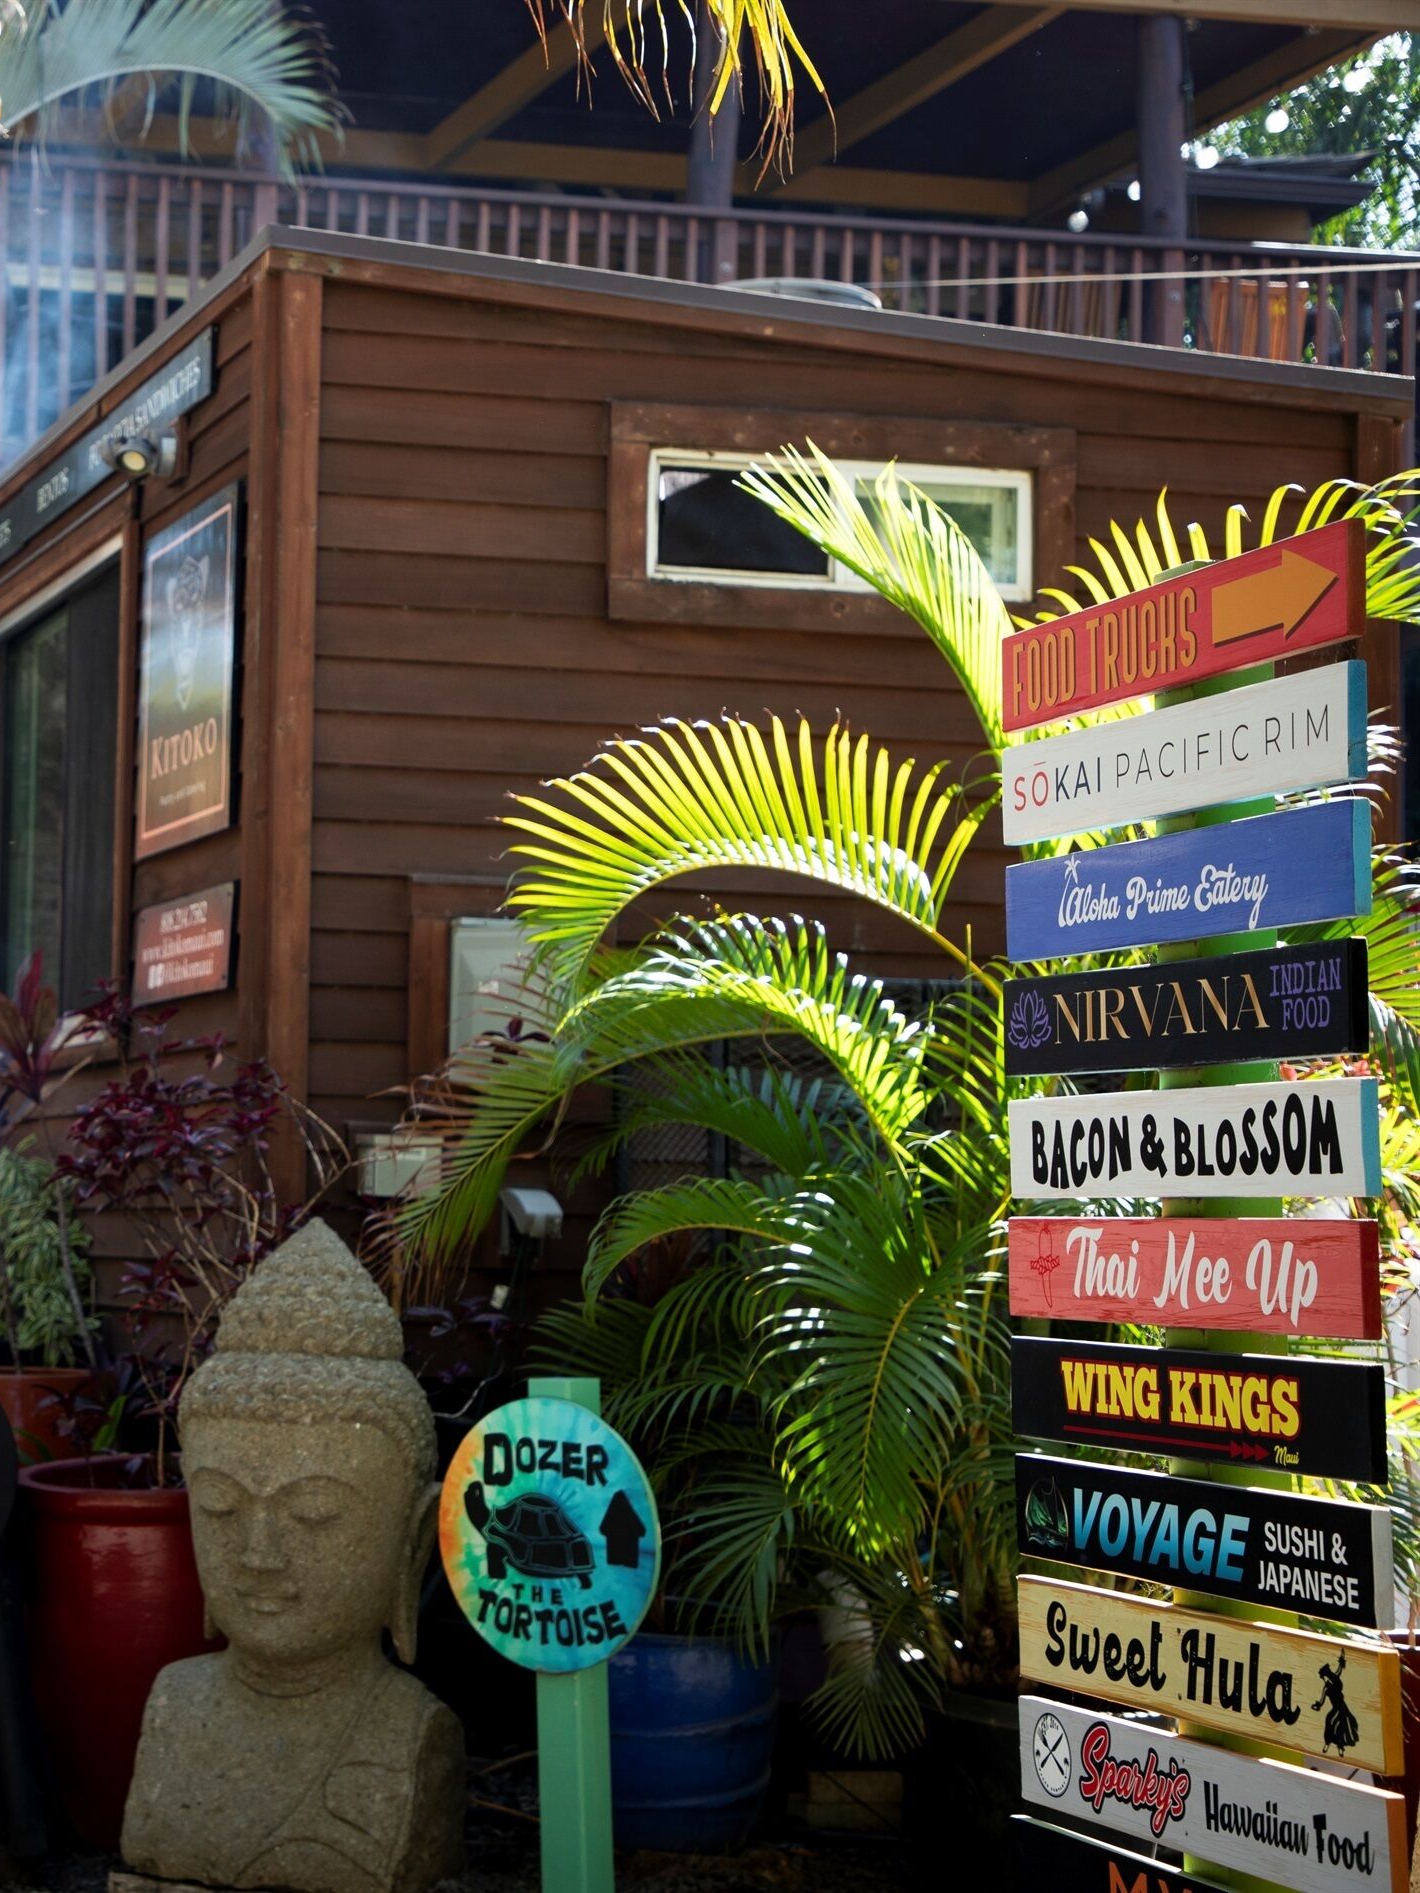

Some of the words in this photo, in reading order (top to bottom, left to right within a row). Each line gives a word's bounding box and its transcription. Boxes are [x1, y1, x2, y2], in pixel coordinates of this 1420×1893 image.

[1012, 627, 1076, 718] FOOD
[1086, 586, 1198, 695] TRUCKS
[151, 717, 217, 779] KITOKO
[1116, 724, 1249, 789] PACIFIC
[1264, 703, 1330, 755] RIM
[1126, 876, 1190, 921] Prime
[1194, 862, 1268, 930] Eatery
[1053, 973, 1271, 1046] NIRVANA
[1269, 957, 1343, 998] INDIAN
[1282, 995, 1331, 1031] FOOD
[1031, 1115, 1132, 1190] BACON
[1140, 1113, 1168, 1178] &
[1174, 1093, 1344, 1177] BLOSSOM
[1066, 1226, 1141, 1300] Thai
[1153, 1230, 1233, 1311] Mee
[1245, 1238, 1320, 1328] Up
[1060, 1358, 1162, 1423] WING
[1168, 1366, 1302, 1440] KINGS
[483, 1432, 609, 1487] DOZER
[1274, 1445, 1300, 1465] Maui
[1073, 1487, 1250, 1583] VOYAGE
[1263, 1521, 1325, 1563] SUSHI
[1331, 1532, 1348, 1566] &
[477, 1588, 629, 1647] TORTOISE
[512, 1583, 563, 1605] THE
[1257, 1559, 1360, 1611] JAPANESE
[1045, 1600, 1167, 1692] Sweet
[1181, 1628, 1301, 1726] Hula
[1079, 1721, 1191, 1839] Sparky's
[1203, 1780, 1309, 1857] Hawaiian
[1312, 1813, 1376, 1876] Food
